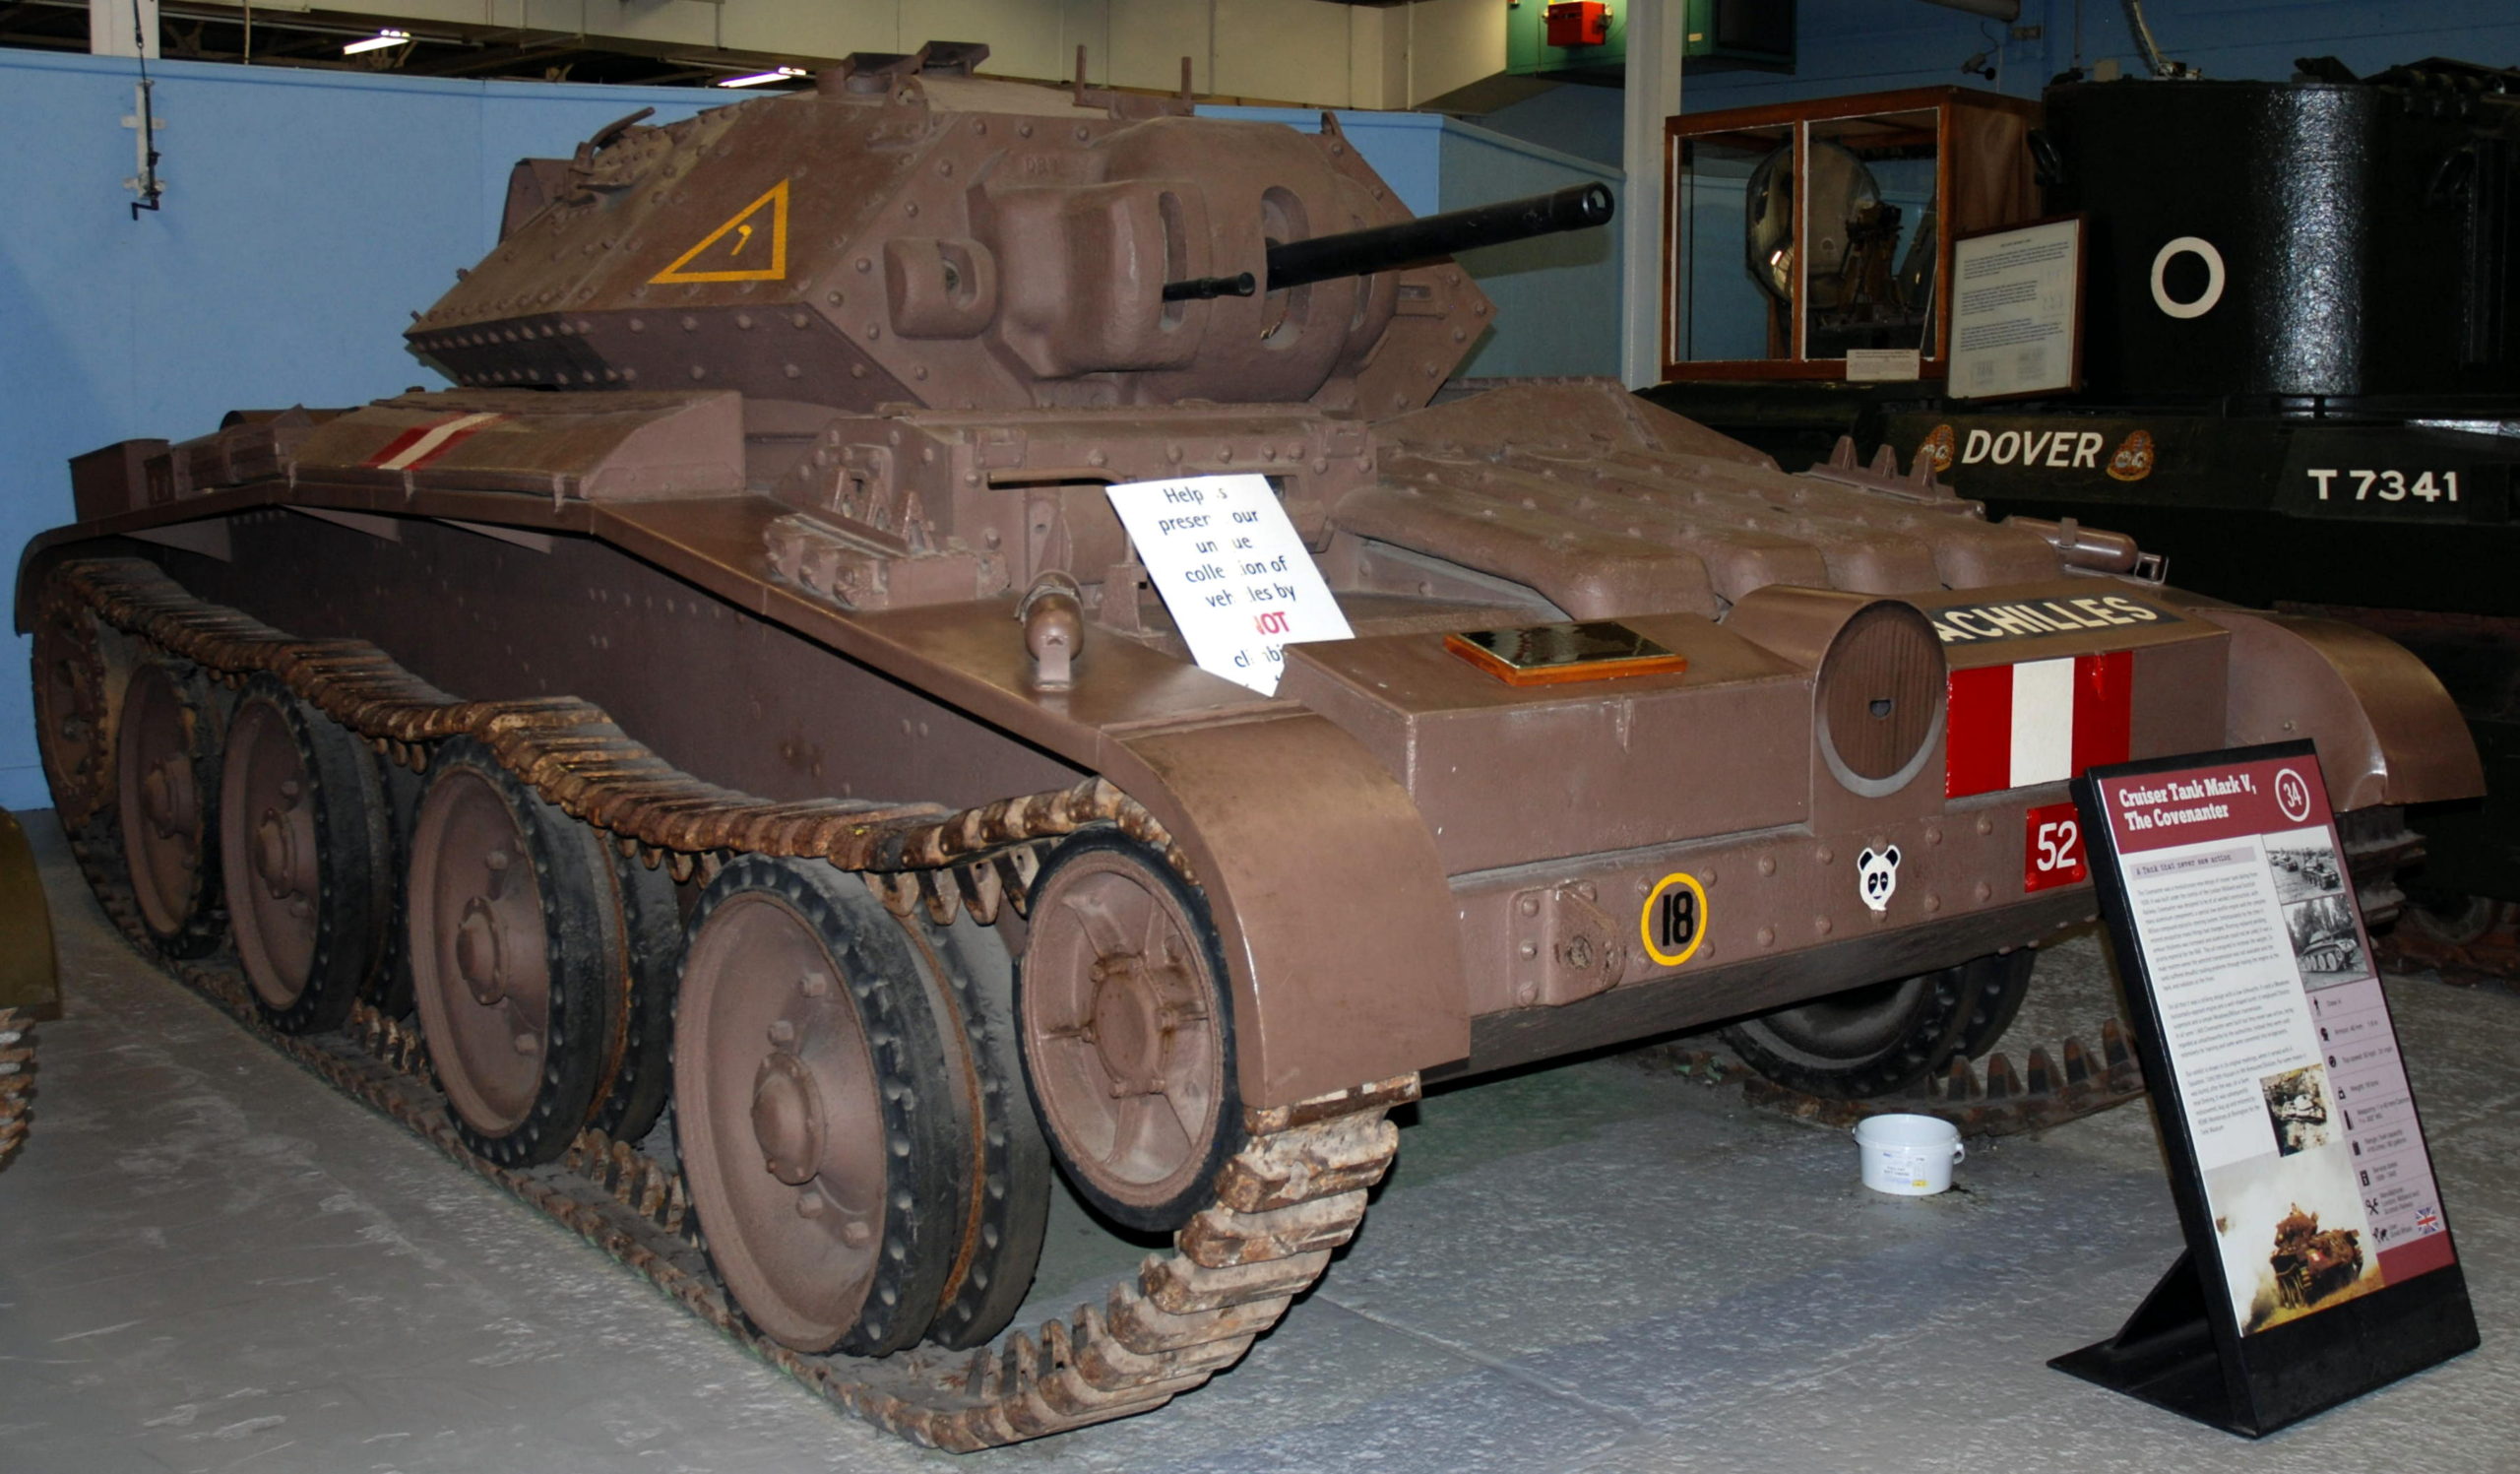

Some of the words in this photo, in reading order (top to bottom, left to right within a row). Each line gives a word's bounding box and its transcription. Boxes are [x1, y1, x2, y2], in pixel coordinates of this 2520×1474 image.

[1961, 429, 2104, 469] DOVER
[1163, 485, 1204, 505] Help
[2307, 468, 2338, 500] T
[2350, 469, 2461, 504] 7341
[1158, 514, 1218, 536] preser
[1231, 510, 1259, 524] our
[1195, 537, 1253, 554] unue
[1185, 558, 1268, 584] colleion
[1271, 555, 1289, 574] of
[1205, 586, 1273, 608] vehles
[1273, 582, 1296, 603] by
[1931, 596, 2159, 643] ACHILLES
[2119, 786, 2168, 807] Cruiser
[2168, 779, 2205, 801] Tank
[2204, 775, 2241, 799] Mark
[2239, 773, 2257, 795] V,
[2283, 781, 2302, 808] 34
[2124, 811, 2153, 831] The
[2153, 803, 2229, 827] Covenanter
[2036, 819, 2078, 872] 52
[1661, 890, 1694, 947] 18
